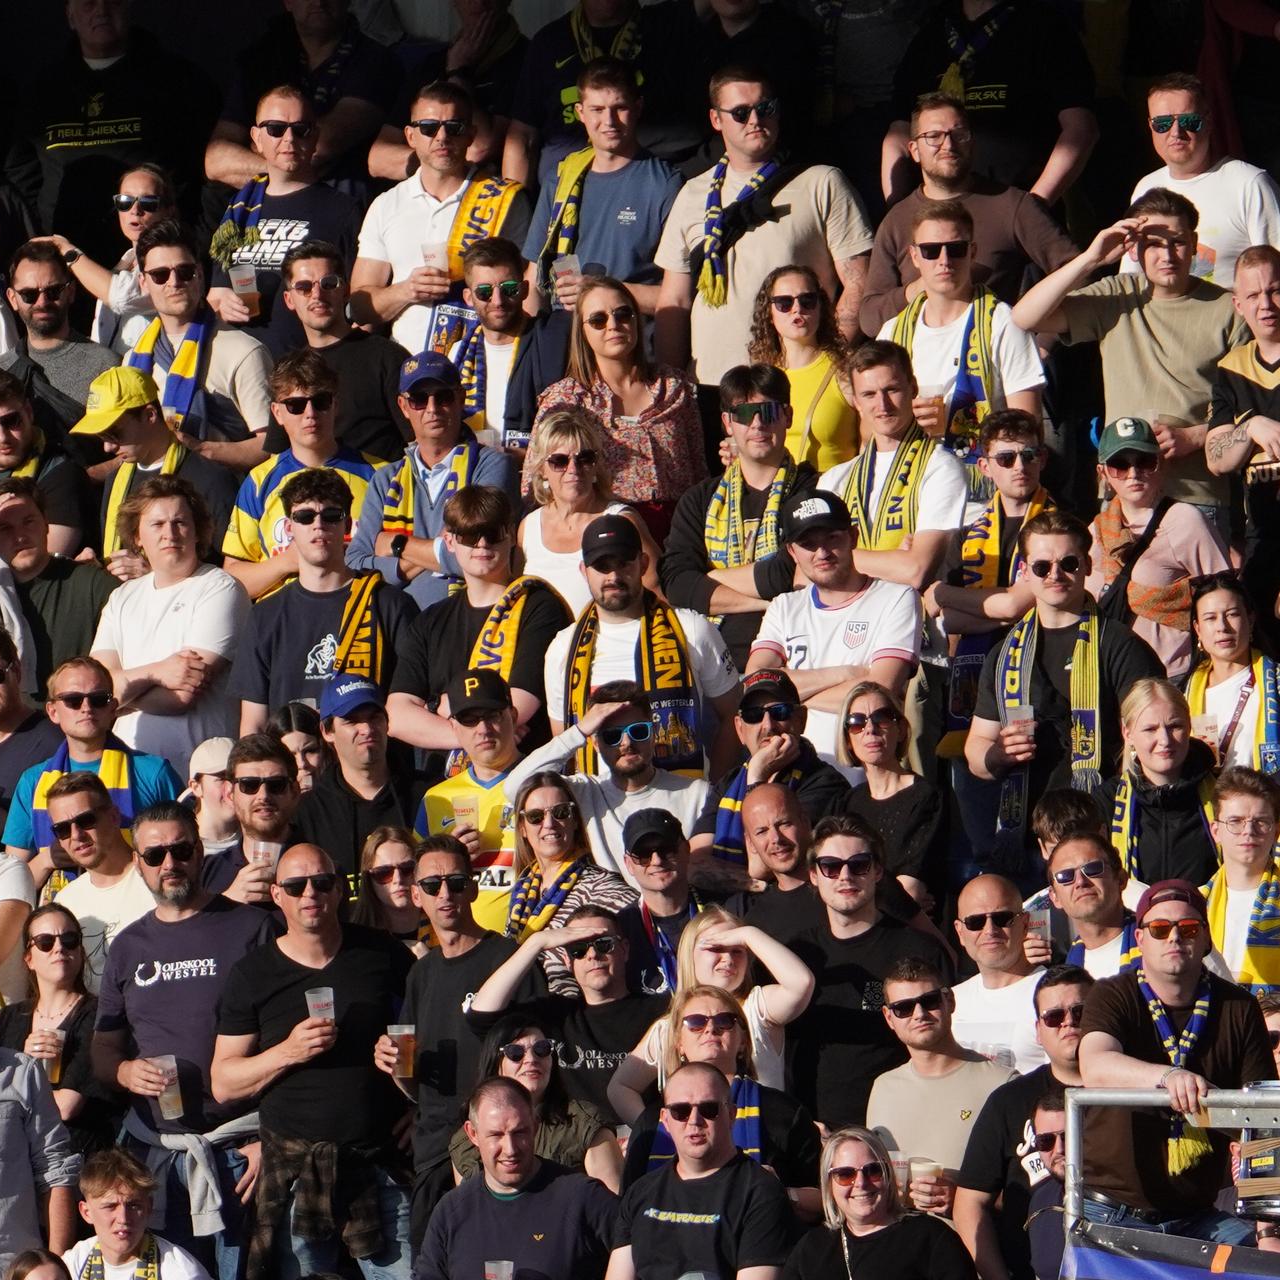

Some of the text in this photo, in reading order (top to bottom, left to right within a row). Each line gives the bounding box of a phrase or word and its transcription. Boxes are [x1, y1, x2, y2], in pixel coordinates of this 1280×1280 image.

[847, 622, 868, 634] USA
[464, 677, 480, 698] P
[161, 958, 217, 973] OLDSKOOL
[161, 967, 218, 982] WESTEL
